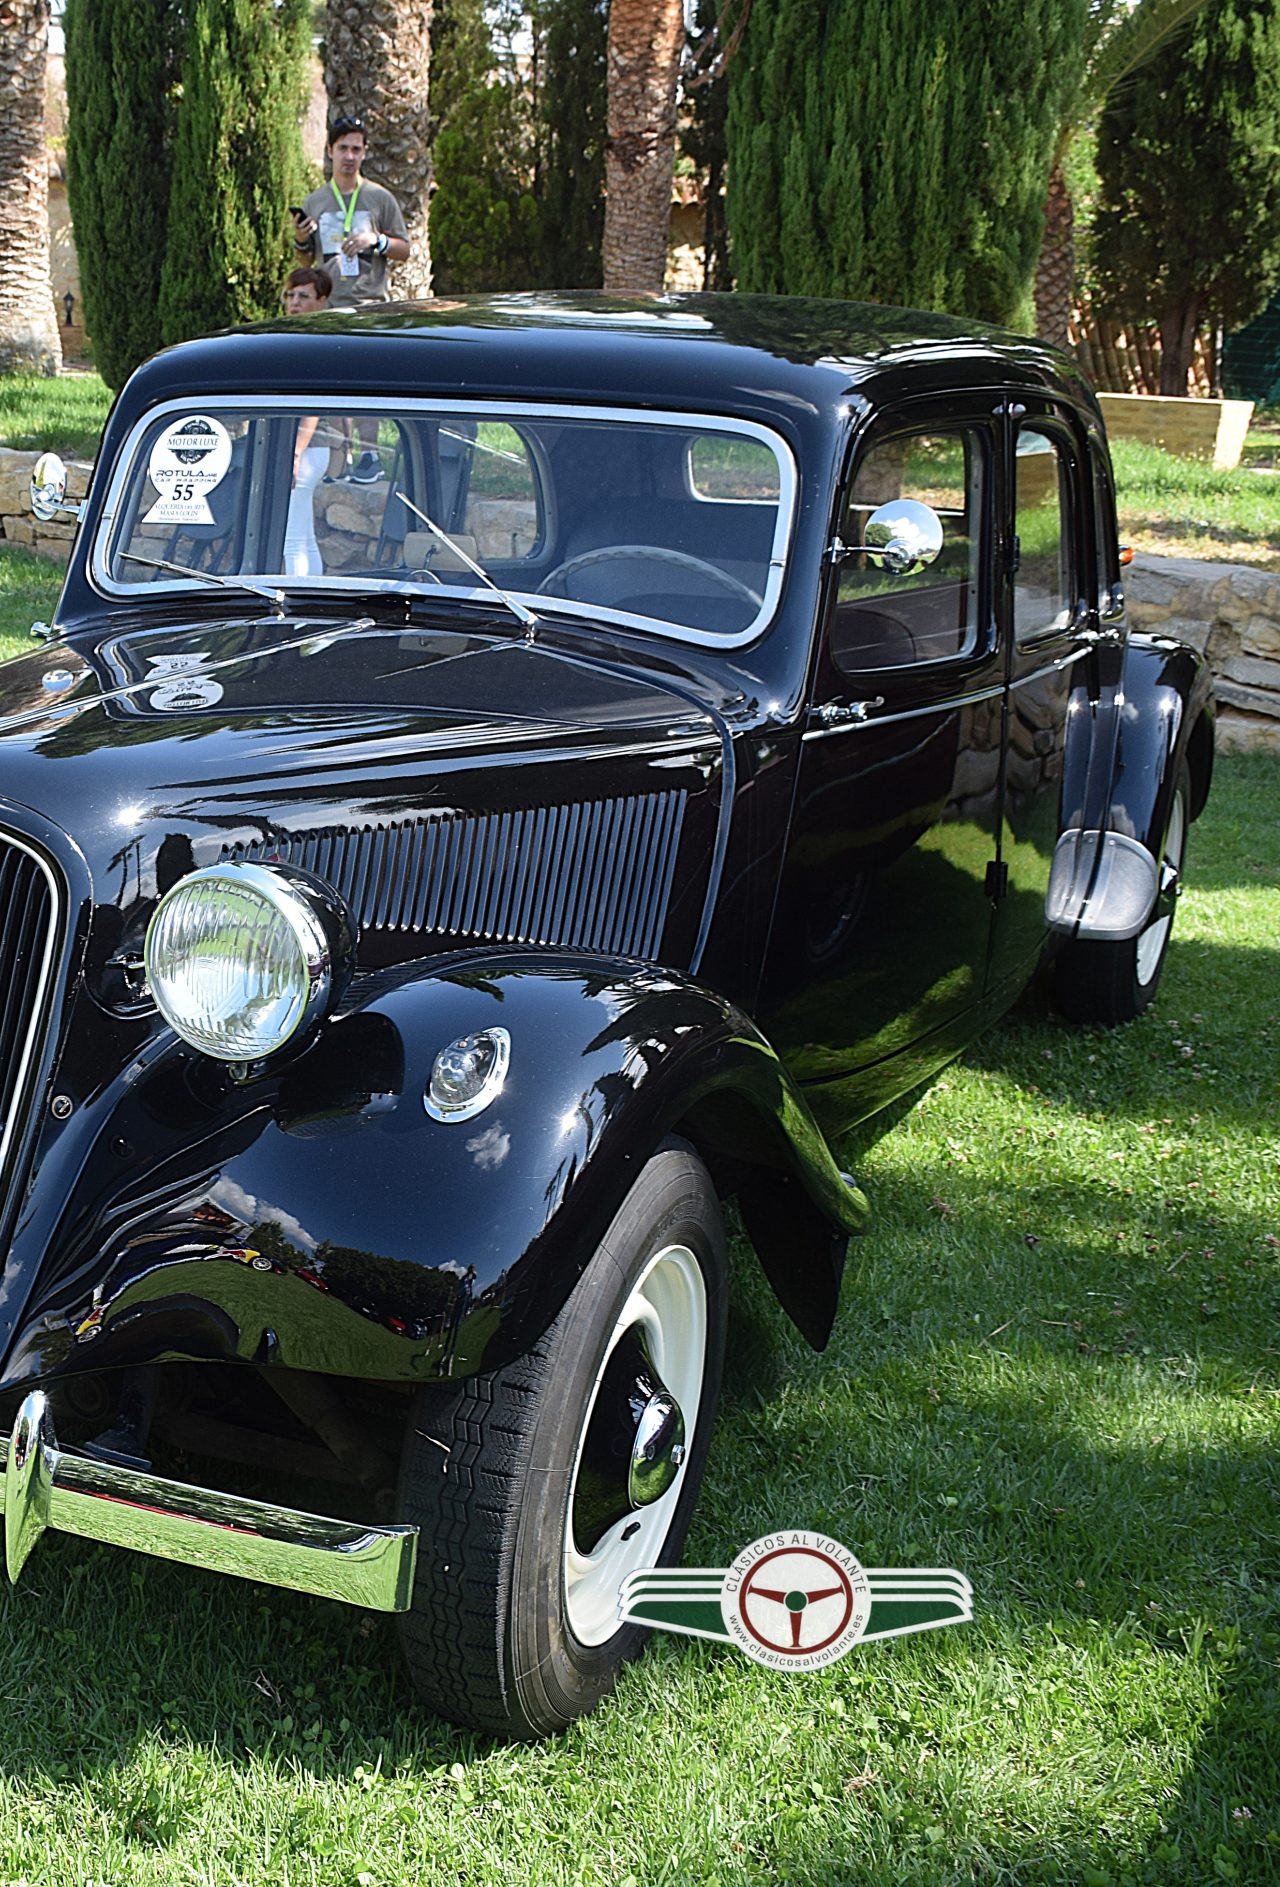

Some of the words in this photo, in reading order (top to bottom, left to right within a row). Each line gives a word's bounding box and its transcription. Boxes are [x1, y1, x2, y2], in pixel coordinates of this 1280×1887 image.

[168, 438, 199, 446] MOTOR
[200, 438, 219, 446] LUXE
[172, 484, 194, 501] 55
